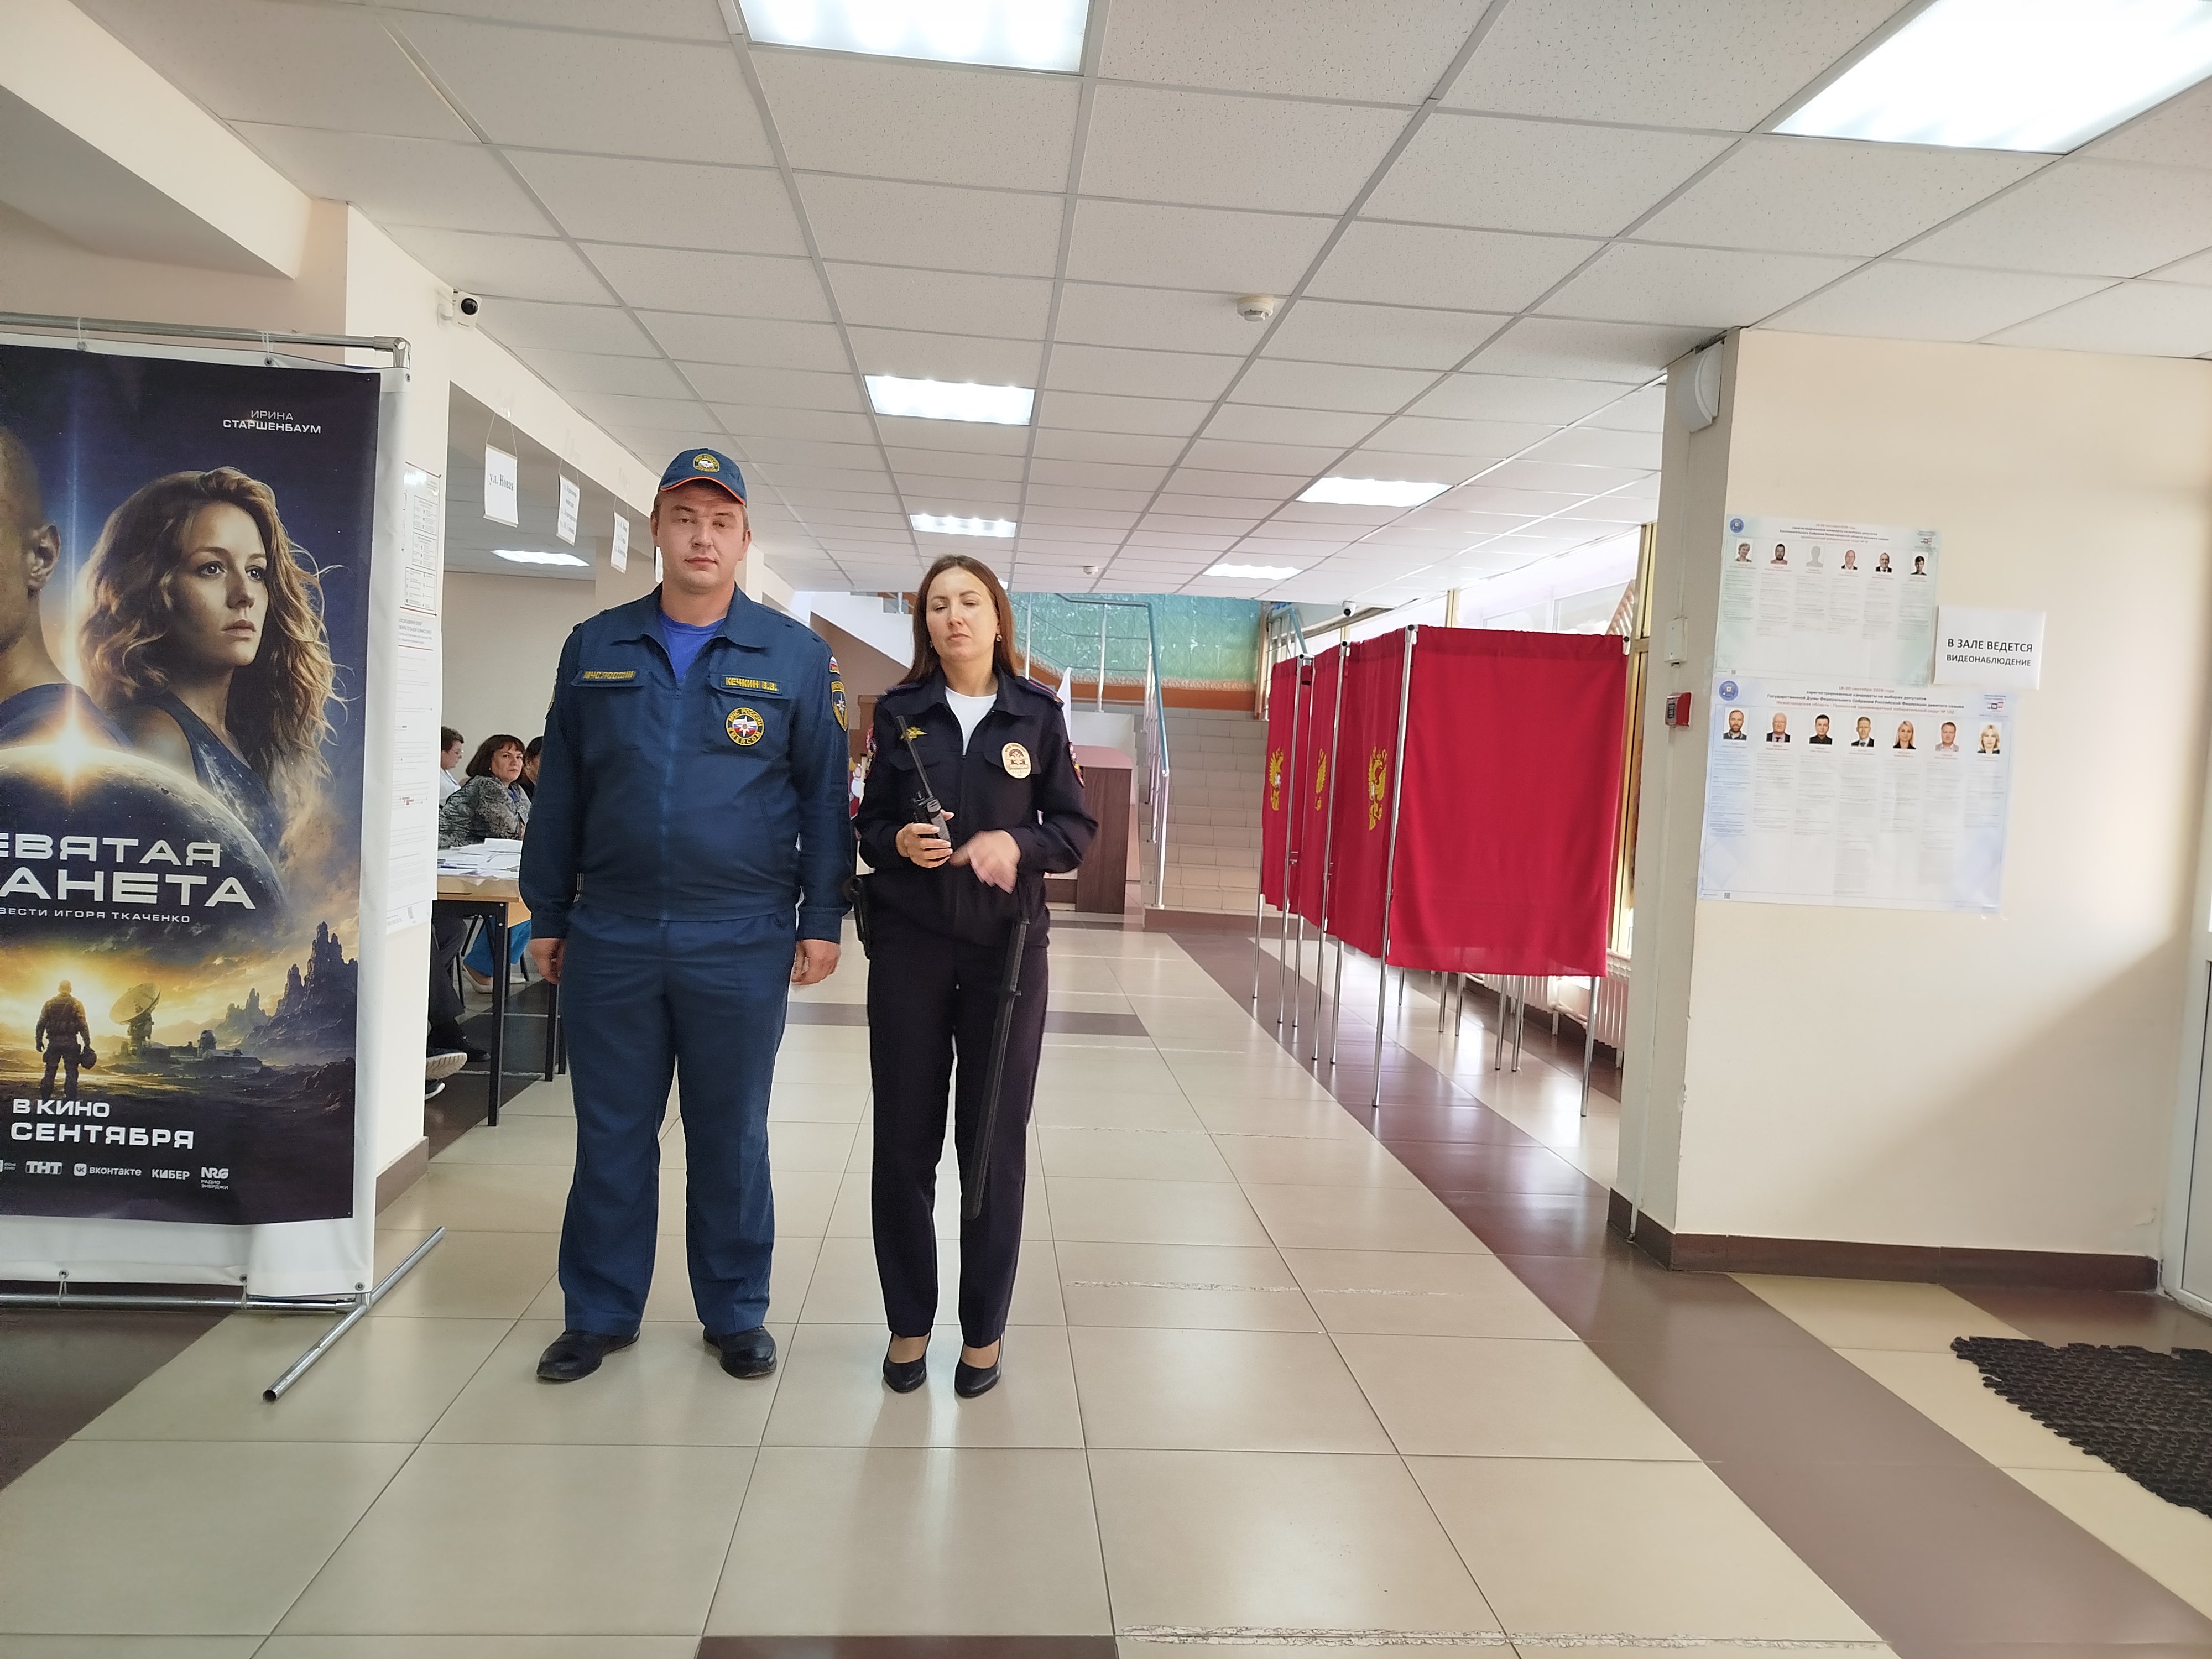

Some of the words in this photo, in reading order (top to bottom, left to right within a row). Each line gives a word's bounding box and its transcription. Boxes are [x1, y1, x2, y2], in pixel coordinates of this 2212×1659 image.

[251, 410, 294, 421] ИРИНА
[223, 419, 321, 434] СТАРШЕНБАУМ
[499, 474, 514, 491] Новая
[1947, 639, 1954, 648] В
[1957, 639, 1984, 649] ЗАЛЕ
[1987, 641, 2033, 653] ВЕДЕТСЯ
[1947, 654, 2031, 666] ВИДЕОНАБЛЮДЕНИЕ
[726, 677, 759, 688] КЕЧКИН
[742, 708, 763, 726] РОССИИ
[727, 727, 761, 745] EMERCOM
[0, 833, 221, 868] ВЯТАЯ
[54, 910, 105, 919] ИГОРЯ
[111, 912, 190, 923] ТКАЧЕНКО
[13, 1098, 30, 1114] В
[36, 1099, 110, 1118] КИНО
[11, 1122, 194, 1149] СЕНТЯБРЯ
[25, 1161, 62, 1175] ТНТ
[89, 1167, 142, 1176] вконтакте
[152, 1168, 190, 1180] КИБЕР
[201, 1167, 229, 1180] NRG
